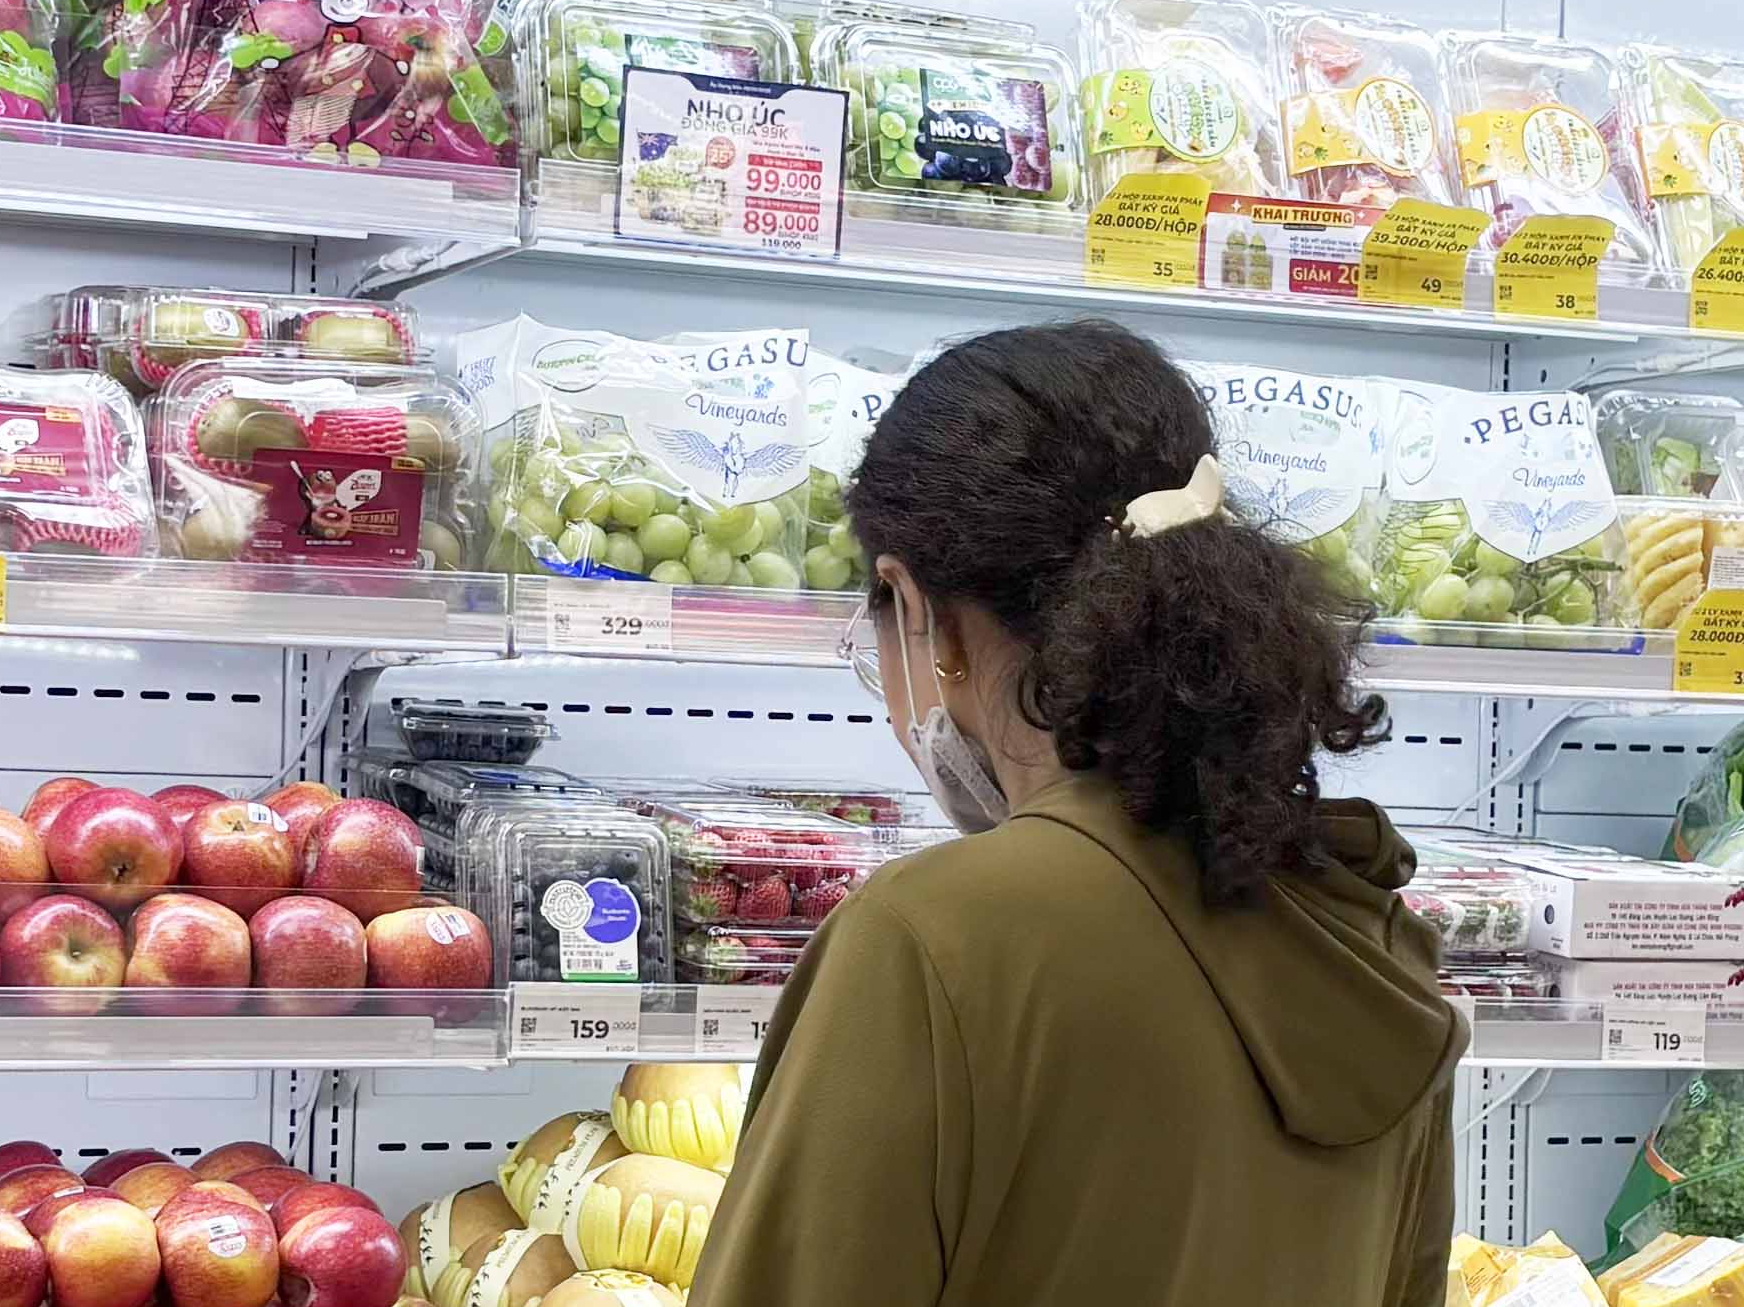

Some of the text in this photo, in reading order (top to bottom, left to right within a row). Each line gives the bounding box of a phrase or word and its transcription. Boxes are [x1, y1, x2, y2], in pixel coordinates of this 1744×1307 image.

[747, 168, 822, 192] 99.000
[744, 211, 819, 235] 89.000
[1253, 207, 1290, 222] KHAI
[1153, 261, 1173, 277] 35
[1556, 295, 1575, 309] 38
[685, 394, 787, 428] Vineyards
[1235, 440, 1327, 473] Vineyards
[1513, 467, 1585, 489] Vineyards
[601, 616, 642, 636] 329
[571, 1020, 609, 1039] 159
[1654, 1033, 1680, 1050] 119
